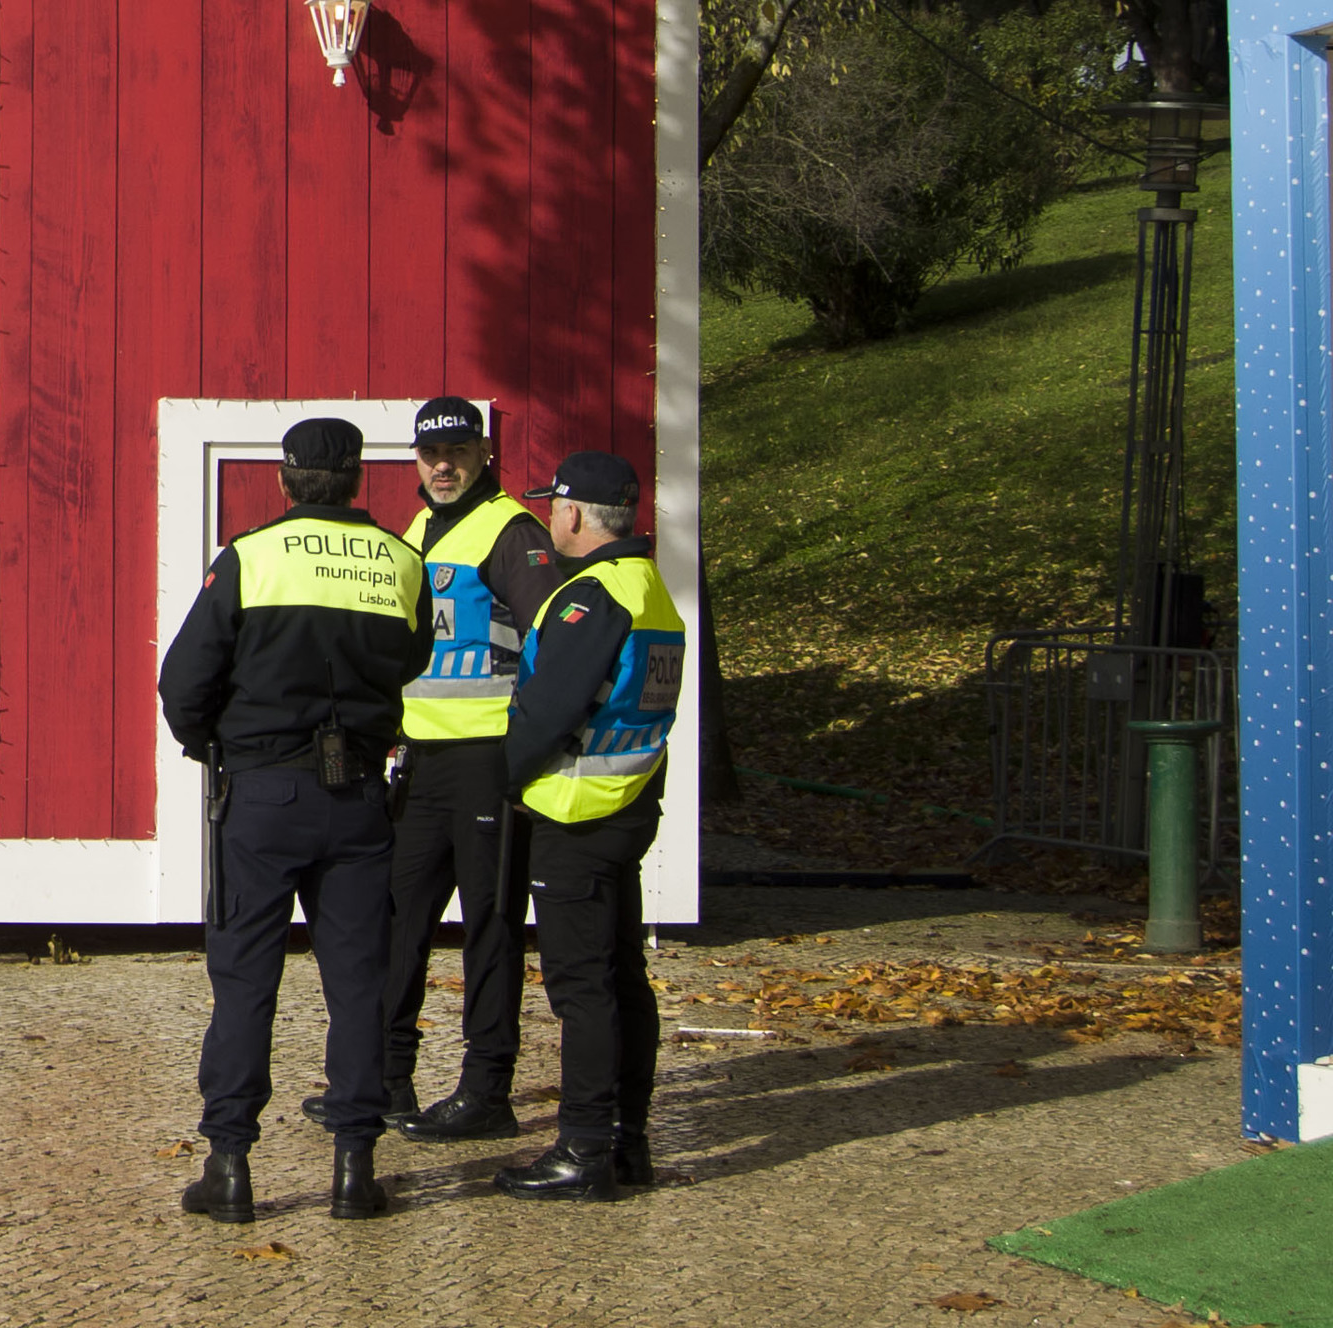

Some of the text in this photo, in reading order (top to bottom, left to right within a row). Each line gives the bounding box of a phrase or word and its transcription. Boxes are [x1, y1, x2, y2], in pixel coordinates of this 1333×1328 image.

[283, 533, 395, 564] POLÍCIA
[315, 565, 397, 588] municipal
[359, 591, 397, 607] Lisboa
